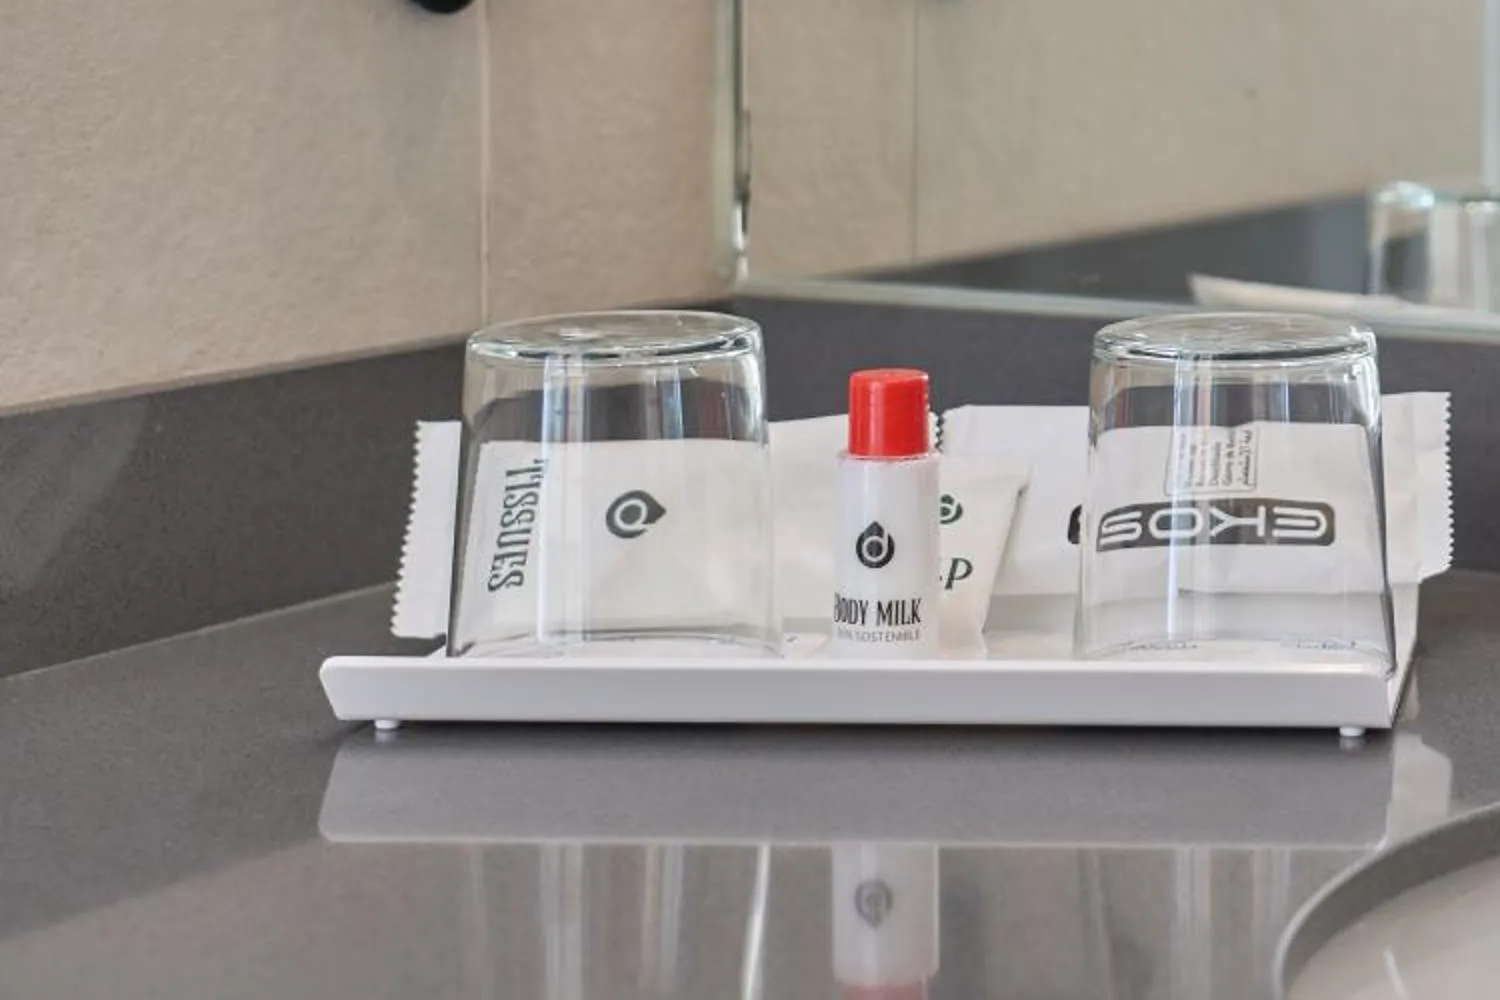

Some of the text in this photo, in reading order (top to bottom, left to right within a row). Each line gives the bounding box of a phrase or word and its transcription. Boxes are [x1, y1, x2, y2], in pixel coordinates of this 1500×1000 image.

[487, 458, 548, 593] TISSUES
[833, 593, 922, 627] BODY MILK
